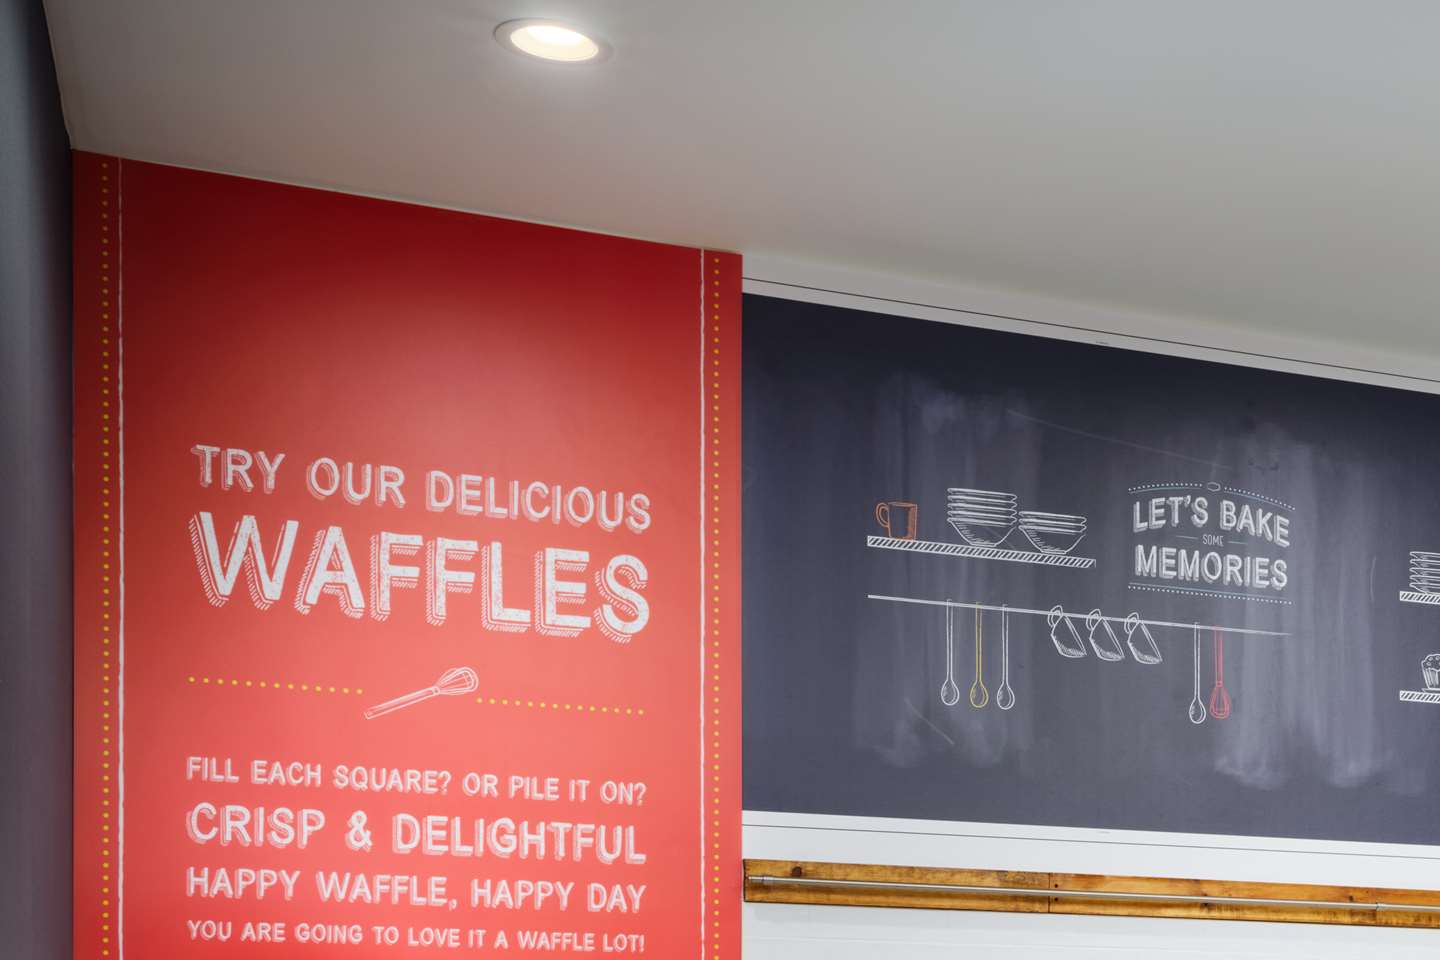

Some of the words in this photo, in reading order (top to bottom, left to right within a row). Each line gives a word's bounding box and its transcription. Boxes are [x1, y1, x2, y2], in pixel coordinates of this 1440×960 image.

[191, 444, 285, 494] TRY
[306, 457, 405, 508] OUR
[426, 470, 651, 534] DELICIOUS
[1133, 495, 1208, 532] LET'S
[1220, 499, 1290, 547] BAKE
[1202, 533, 1224, 547] SOME
[188, 511, 650, 643] WAFFLES
[1135, 544, 1288, 591] MEMORIES
[187, 756, 239, 783] FILL
[251, 760, 321, 787] EACH
[334, 765, 451, 795] SQUARE?
[463, 772, 498, 798] OR
[508, 775, 560, 800] PILE
[569, 779, 590, 802] IT
[600, 781, 647, 806] ON?
[186, 802, 325, 849] CRISP
[345, 810, 372, 852] &
[392, 813, 647, 864] DELIGHTFUL
[186, 867, 300, 900] HAPPY
[316, 871, 457, 911] WAFFLE,
[470, 878, 574, 911] HAPPY
[587, 882, 646, 913] DAY
[187, 920, 231, 942] YOU
[240, 922, 286, 942] ARE
[294, 923, 363, 944] GOING
[373, 926, 399, 945] TO
[407, 927, 460, 948] LOVE
[468, 929, 486, 948] IT
[494, 930, 508, 949] A
[517, 930, 595, 951] WAFFLE
[602, 933, 645, 953] LOT!
